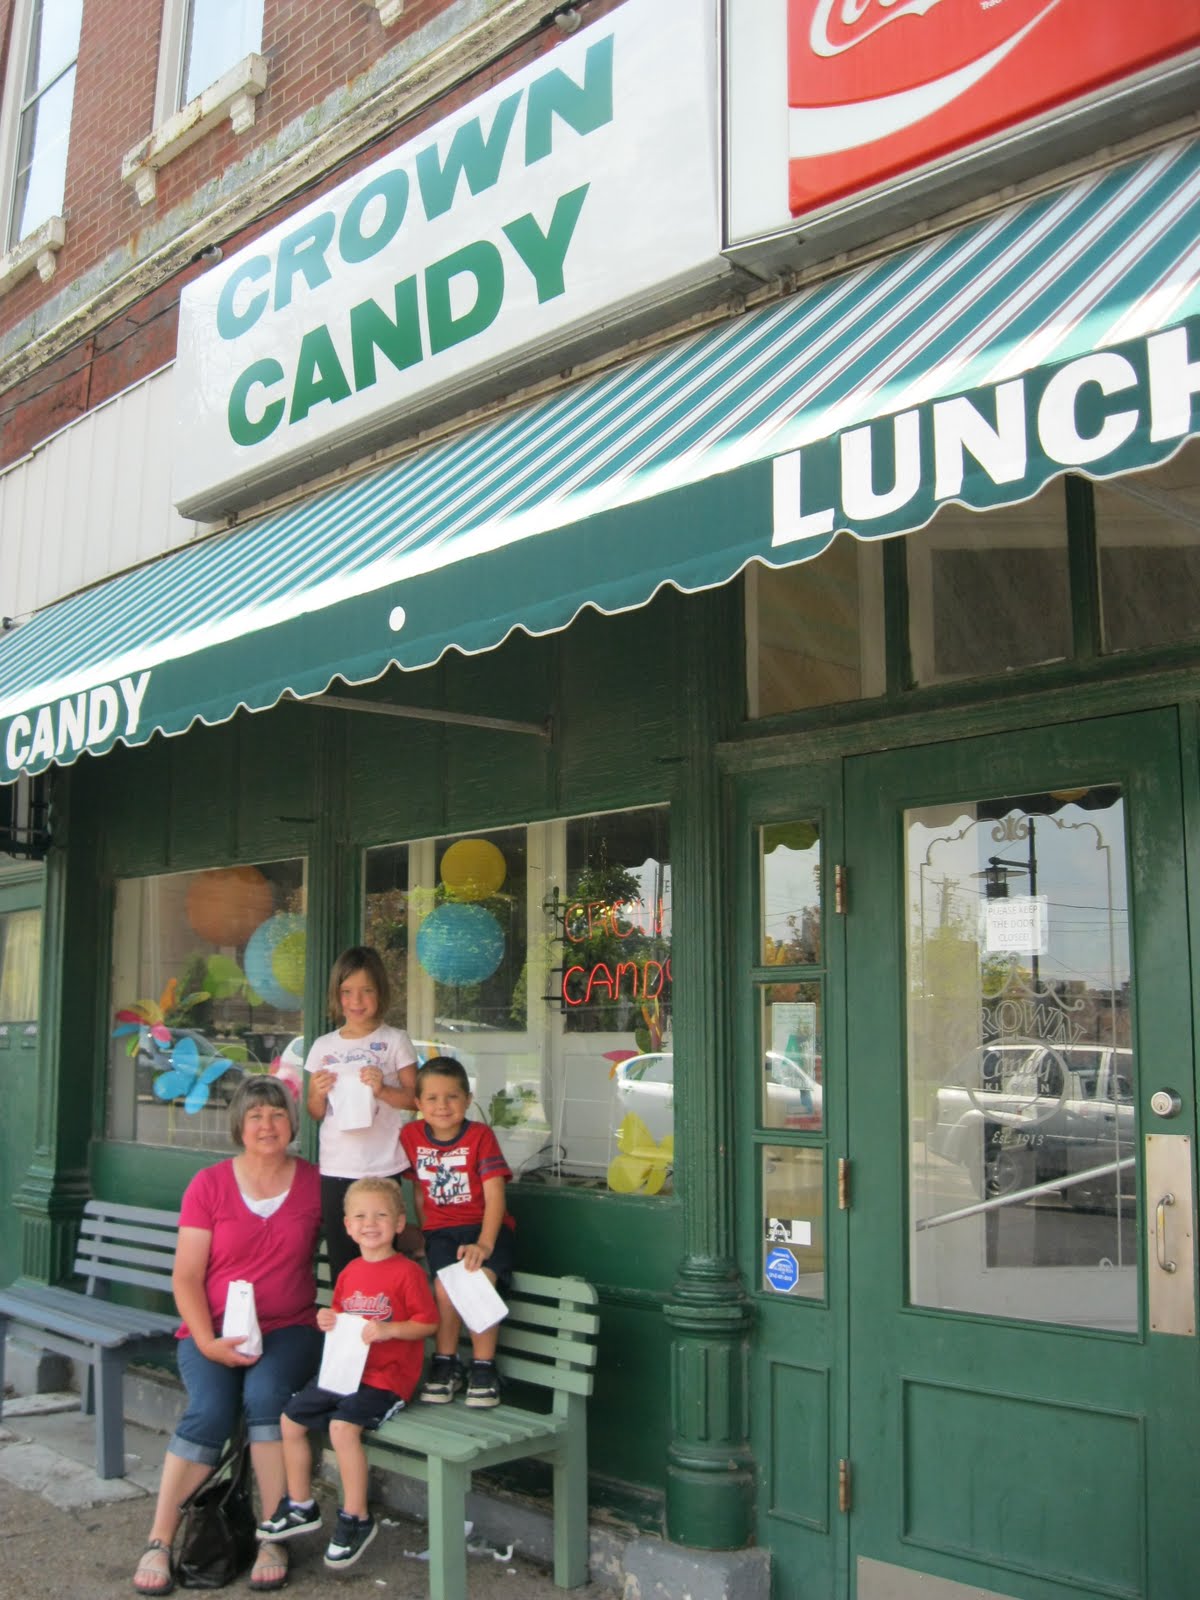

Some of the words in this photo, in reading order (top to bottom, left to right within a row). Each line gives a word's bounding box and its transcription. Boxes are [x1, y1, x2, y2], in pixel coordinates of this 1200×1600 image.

[216, 33, 615, 340] CROWN
[227, 181, 591, 447] CANDY
[6, 671, 151, 770] CANDY
[992, 920, 1008, 928] THE
[1010, 919, 1035, 928] DOOR
[1019, 905, 1038, 914] KEEP
[563, 961, 672, 1005] CAND
[978, 1000, 1087, 1055] ROWN
[1016, 1134, 1045, 1146] 1913
